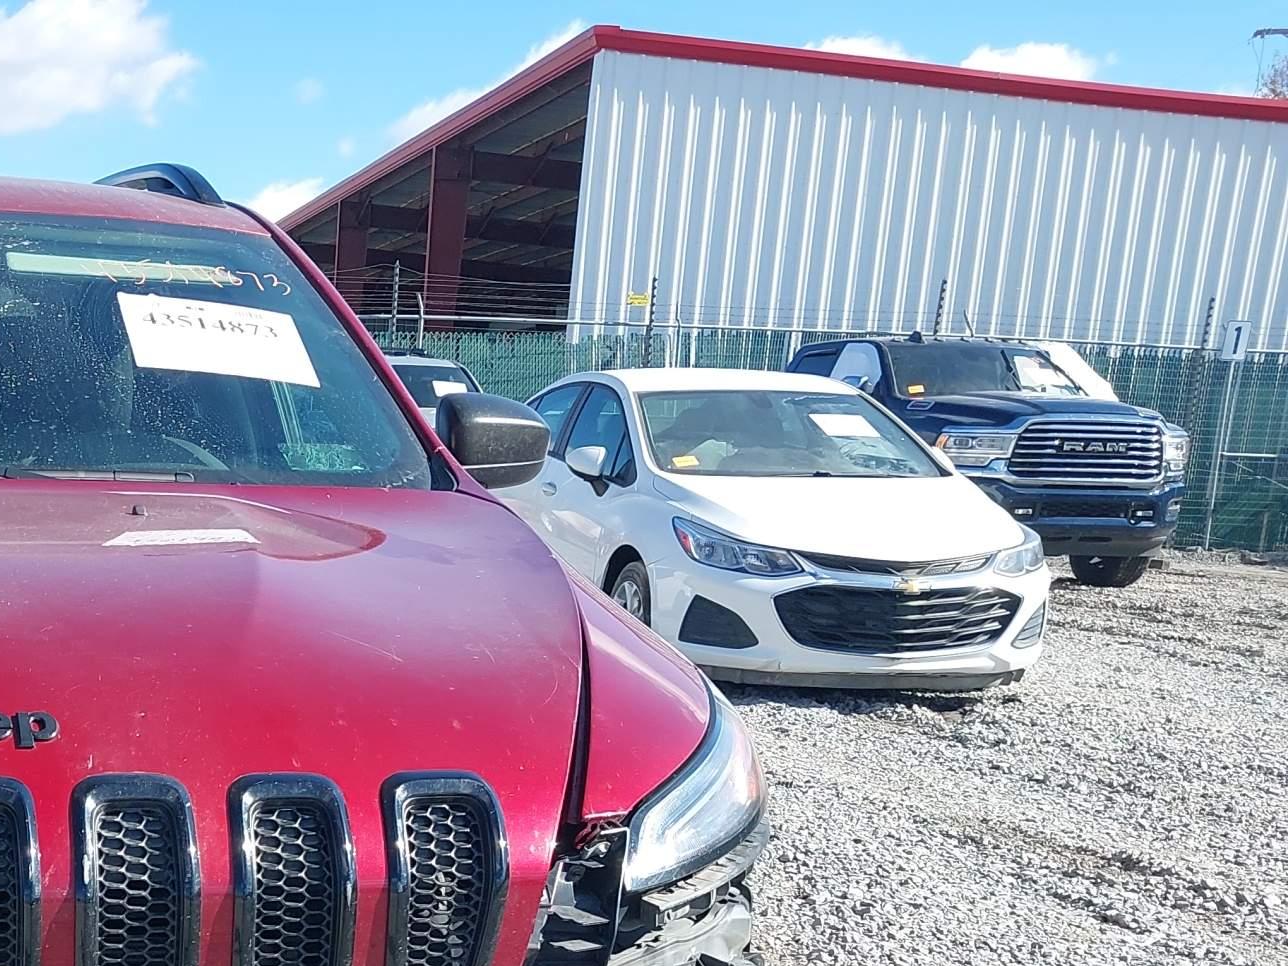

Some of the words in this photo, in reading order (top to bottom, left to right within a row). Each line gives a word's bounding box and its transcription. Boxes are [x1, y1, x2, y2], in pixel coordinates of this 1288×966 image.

[143, 312, 278, 338] 43514873
[1232, 325, 1244, 355] 1
[1062, 440, 1129, 453] RAM
